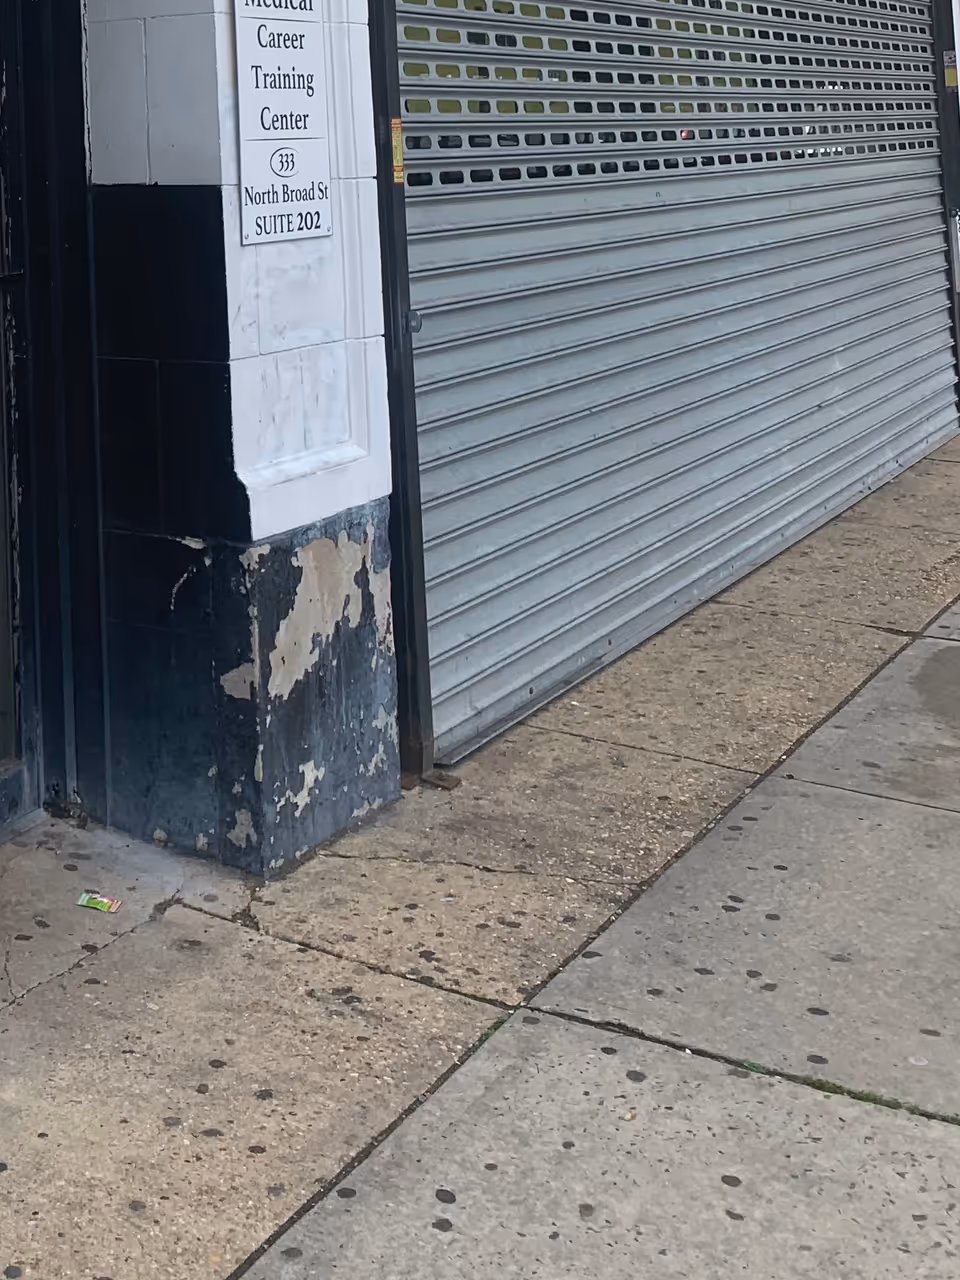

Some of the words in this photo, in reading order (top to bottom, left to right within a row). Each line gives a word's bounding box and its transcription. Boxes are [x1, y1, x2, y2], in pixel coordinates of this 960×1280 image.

[257, 24, 305, 50] Career
[251, 65, 315, 98] Training
[260, 106, 309, 131] Center
[278, 153, 295, 172] 333
[244, 184, 280, 207] North
[282, 181, 315, 203] Broad
[318, 181, 329, 200] St
[256, 213, 294, 236] SUITE
[297, 210, 321, 231] 202
